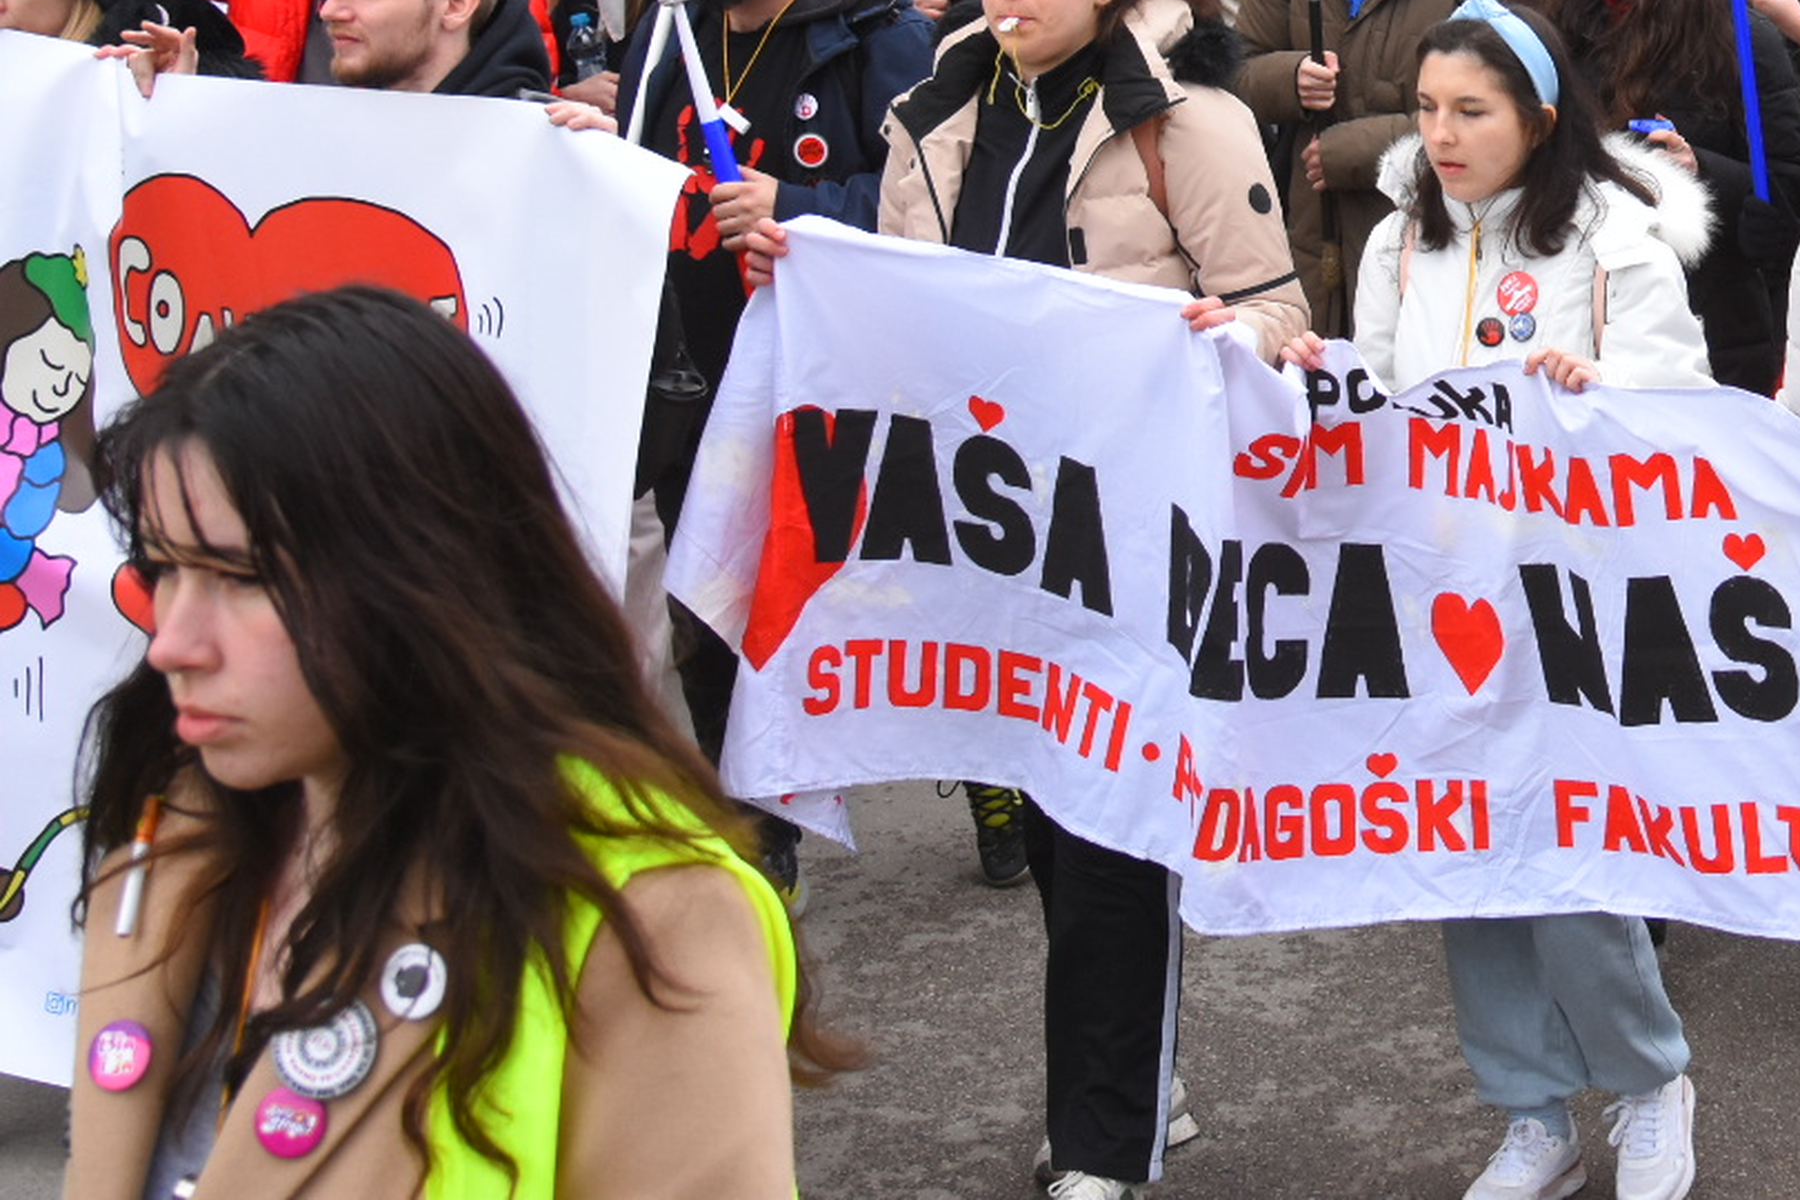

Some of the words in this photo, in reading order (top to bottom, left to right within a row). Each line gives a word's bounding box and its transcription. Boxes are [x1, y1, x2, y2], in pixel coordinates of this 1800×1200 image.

[794, 396, 1113, 617] VAŠA
[1167, 502, 1411, 702] DECA
[1518, 533, 1800, 726] NAŠ
[1408, 417, 1739, 528] MAJKAMA
[803, 639, 1131, 773] STUDENTI
[1172, 732, 1490, 863] PDAGOŠKI
